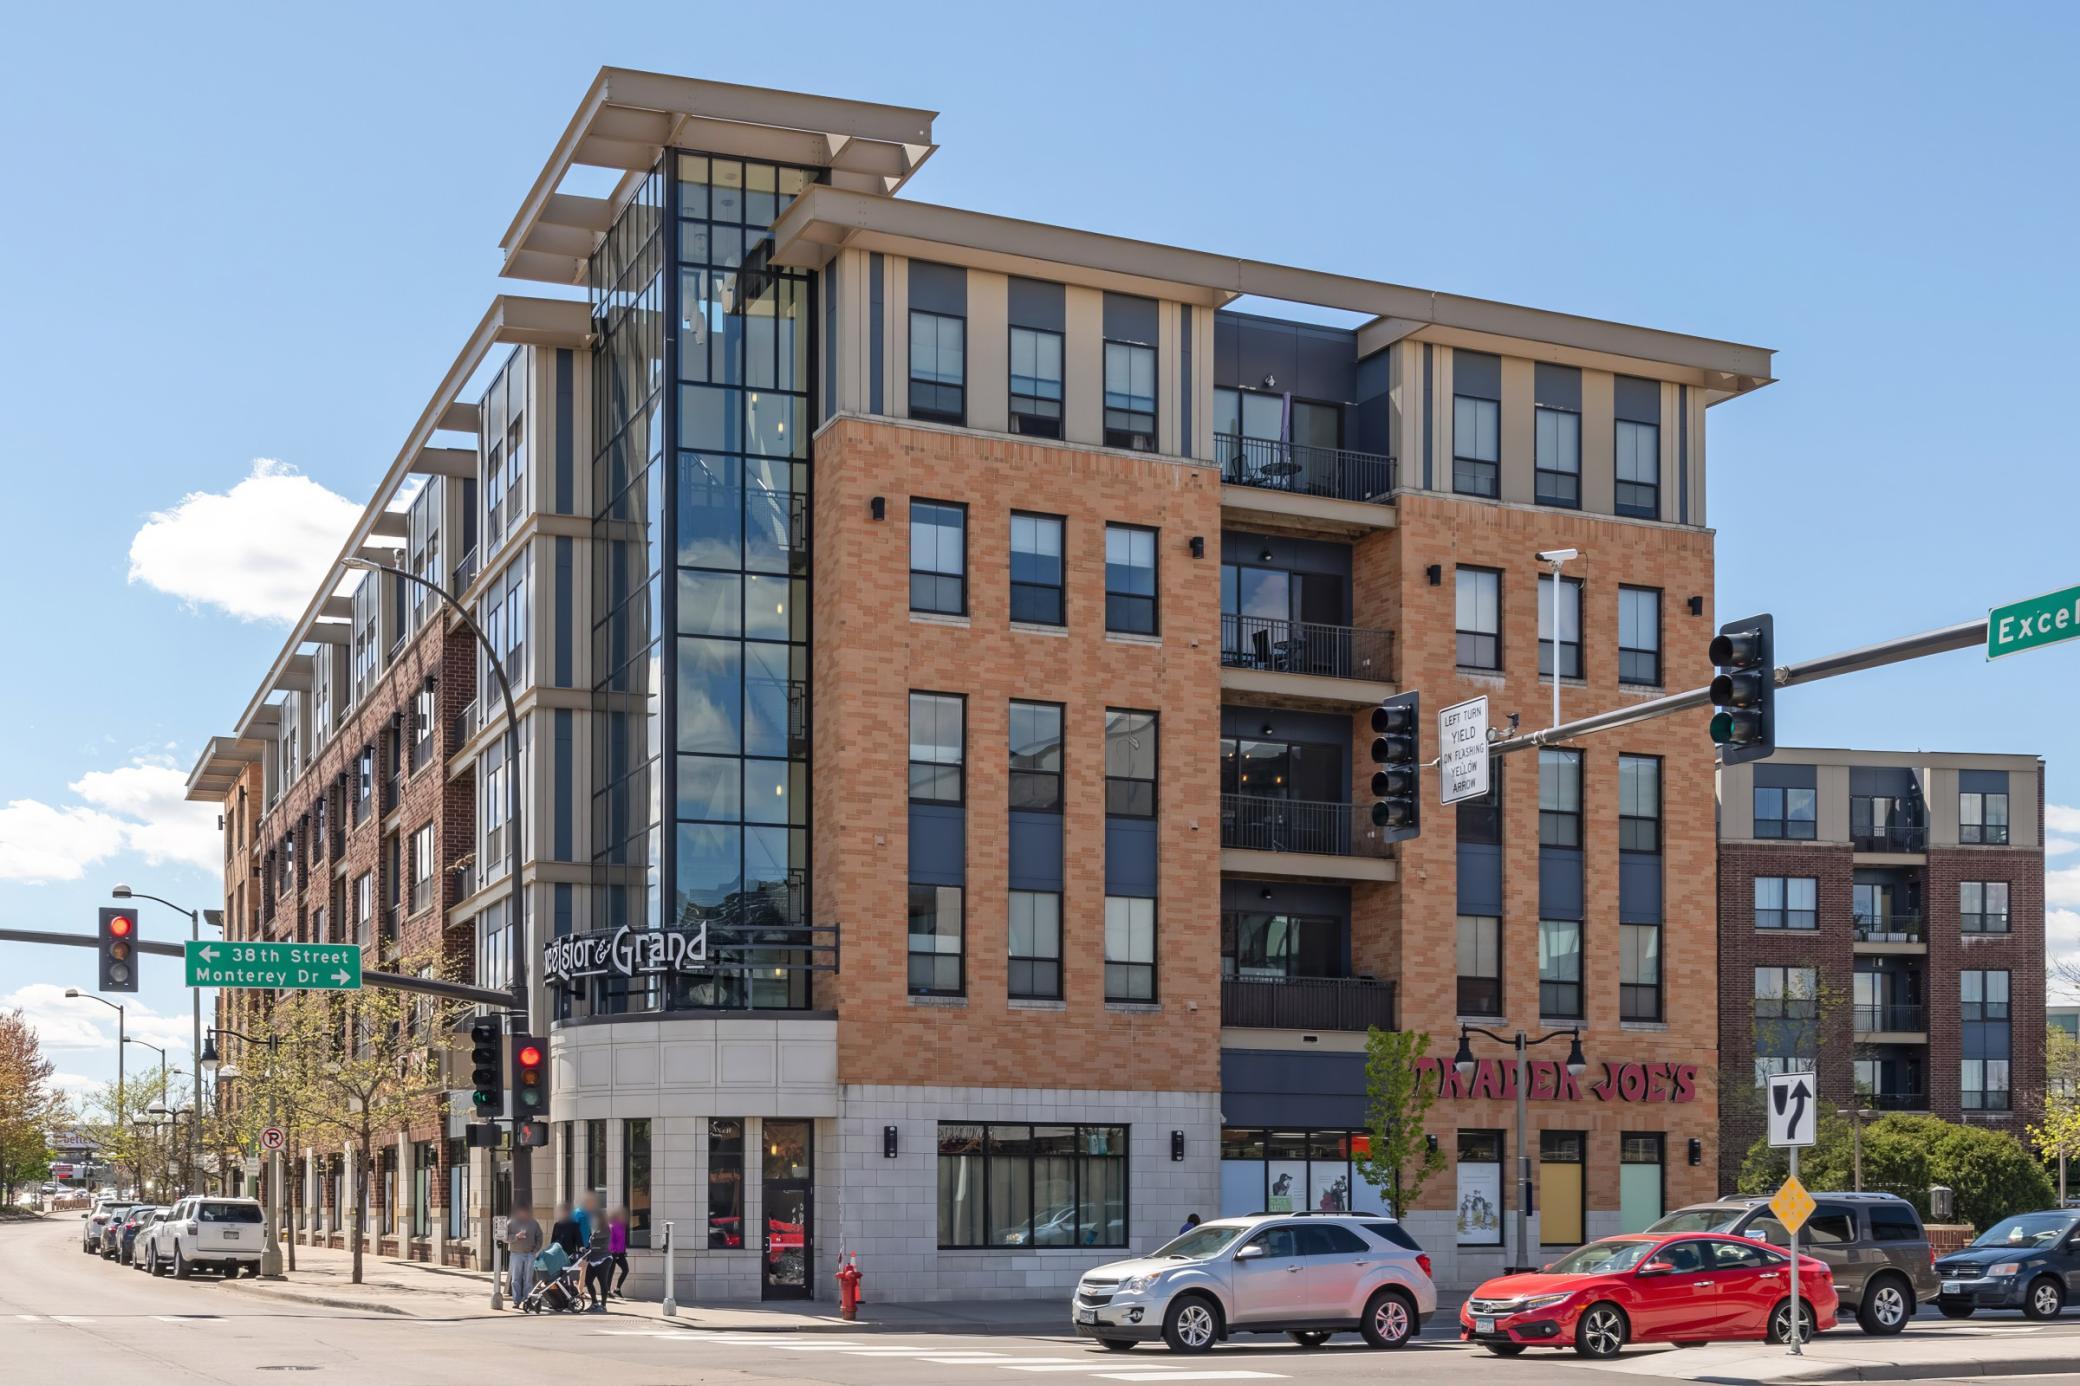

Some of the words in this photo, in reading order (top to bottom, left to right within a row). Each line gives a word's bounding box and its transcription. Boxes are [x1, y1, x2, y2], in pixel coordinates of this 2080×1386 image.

[1445, 713, 1460, 727] LEFT
[1464, 706, 1482, 720] TURN
[1451, 726, 1476, 744] YIELD
[1443, 753, 1452, 764] ON
[1455, 743, 1484, 761] FLASHING
[1451, 761, 1477, 777] YELLOW
[1453, 779, 1476, 793] ARROW
[232, 948, 279, 963] 38th
[291, 949, 348, 964] Street
[595, 939, 611, 965] &
[612, 920, 707, 977] Grand
[196, 967, 286, 986] Monterey
[298, 970, 319, 983] Dr
[1591, 1062, 1698, 1103] JOE'S
